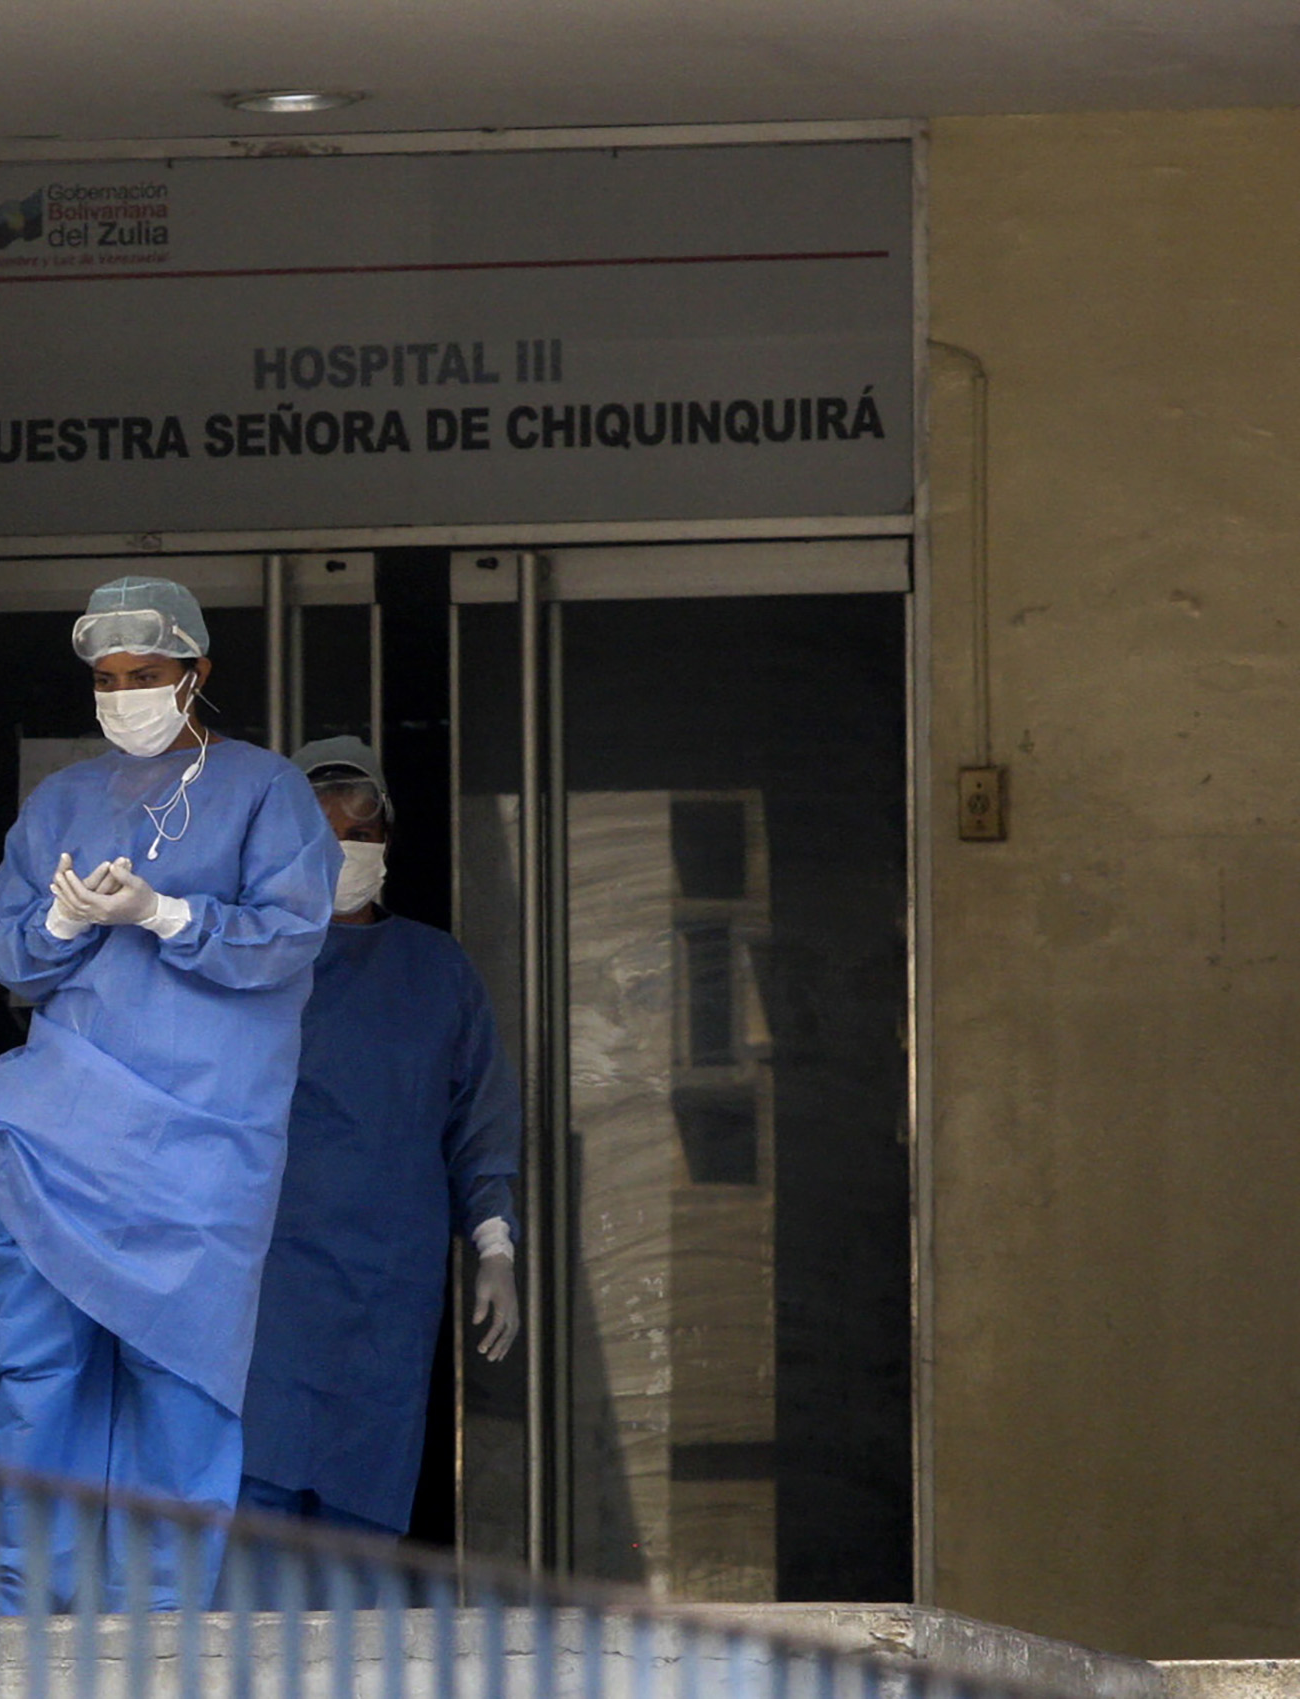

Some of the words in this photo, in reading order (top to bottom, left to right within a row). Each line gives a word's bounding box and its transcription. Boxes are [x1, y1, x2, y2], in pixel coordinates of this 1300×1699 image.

[47, 182, 168, 202] Gobernación
[47, 201, 168, 223] Bolivariana
[47, 223, 88, 248] del
[98, 220, 169, 247] Zulia
[254, 342, 500, 390] HOSPITAL
[516, 339, 563, 383] III
[204, 402, 411, 457] SEÑORA
[426, 407, 490, 452] DE
[506, 385, 885, 450] CHIQUINQUIRÁ
